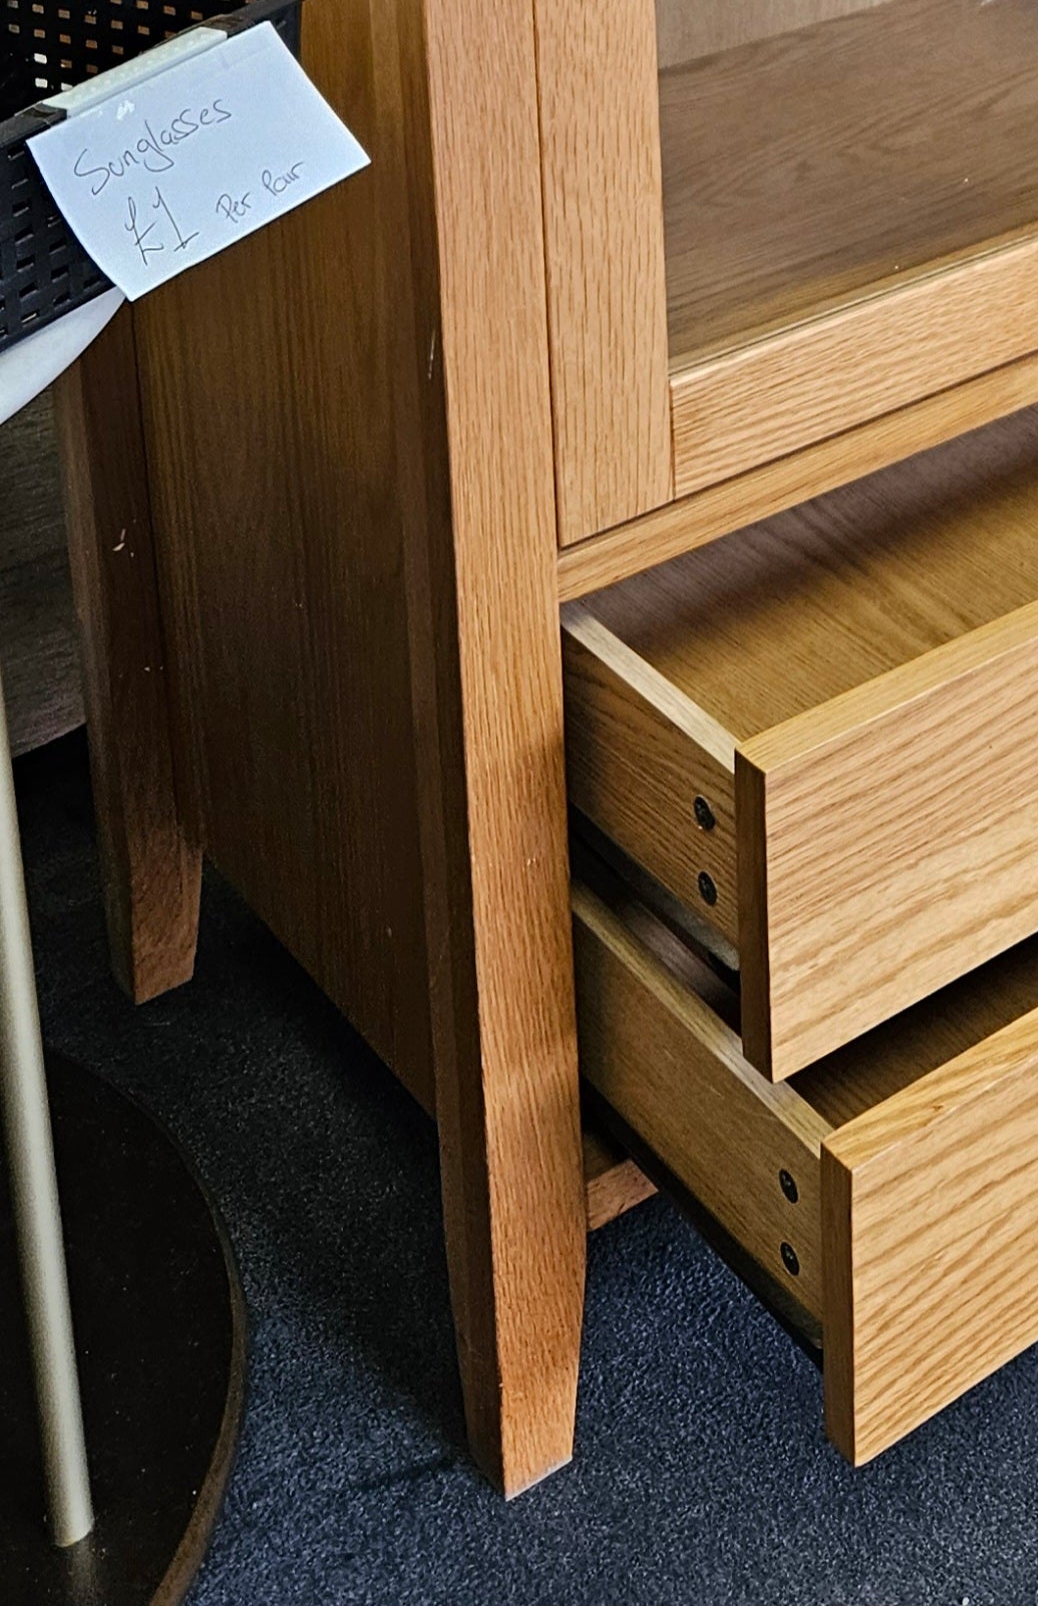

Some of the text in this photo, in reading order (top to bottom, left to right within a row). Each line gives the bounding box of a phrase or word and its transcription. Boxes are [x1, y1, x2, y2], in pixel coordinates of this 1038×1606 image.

[74, 98, 232, 195] Sunglasses
[125, 161, 305, 265] £1 Per Pair
